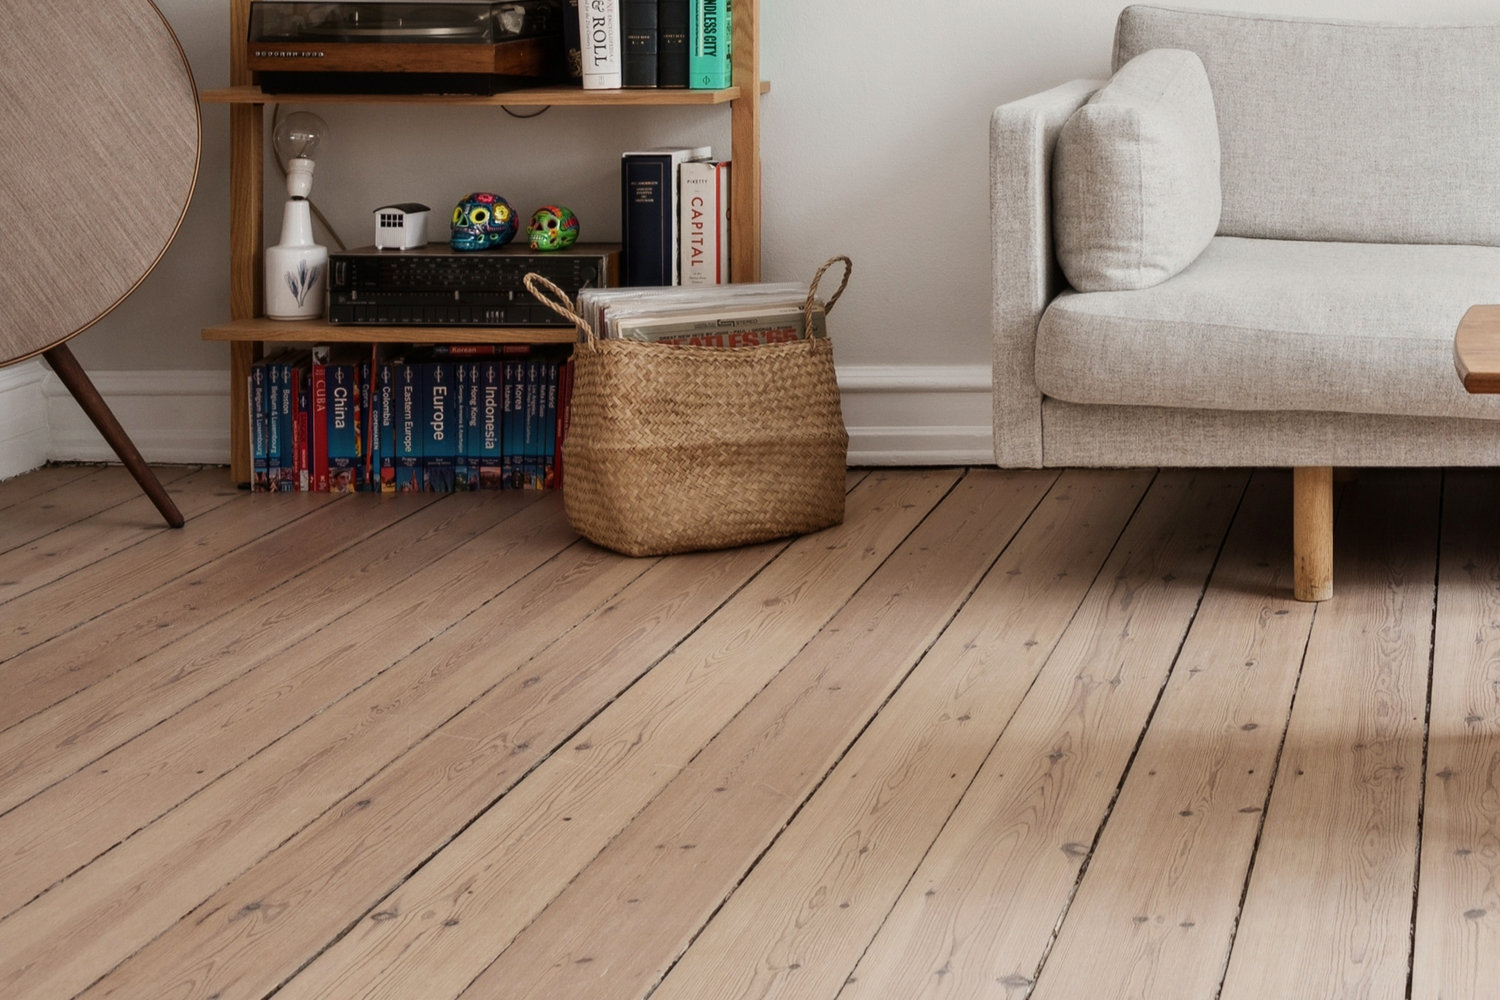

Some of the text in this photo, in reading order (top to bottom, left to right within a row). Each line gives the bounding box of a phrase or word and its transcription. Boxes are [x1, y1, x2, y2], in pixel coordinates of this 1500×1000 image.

[592, 0, 603, 12] &
[592, 17, 607, 67] ROLL
[704, 36, 717, 57] CITY
[691, 196, 704, 267] CAPITAL
[316, 380, 325, 412] CUBA
[334, 387, 347, 429] China
[362, 384, 370, 408] Cyprus
[382, 386, 390, 426] Colombia
[431, 386, 447, 441] Europe
[470, 385, 478, 427] Hong Kong
[515, 384, 523, 410] Korea
[404, 386, 413, 453] Eastern Europe
[485, 386, 497, 449] Indonesia
